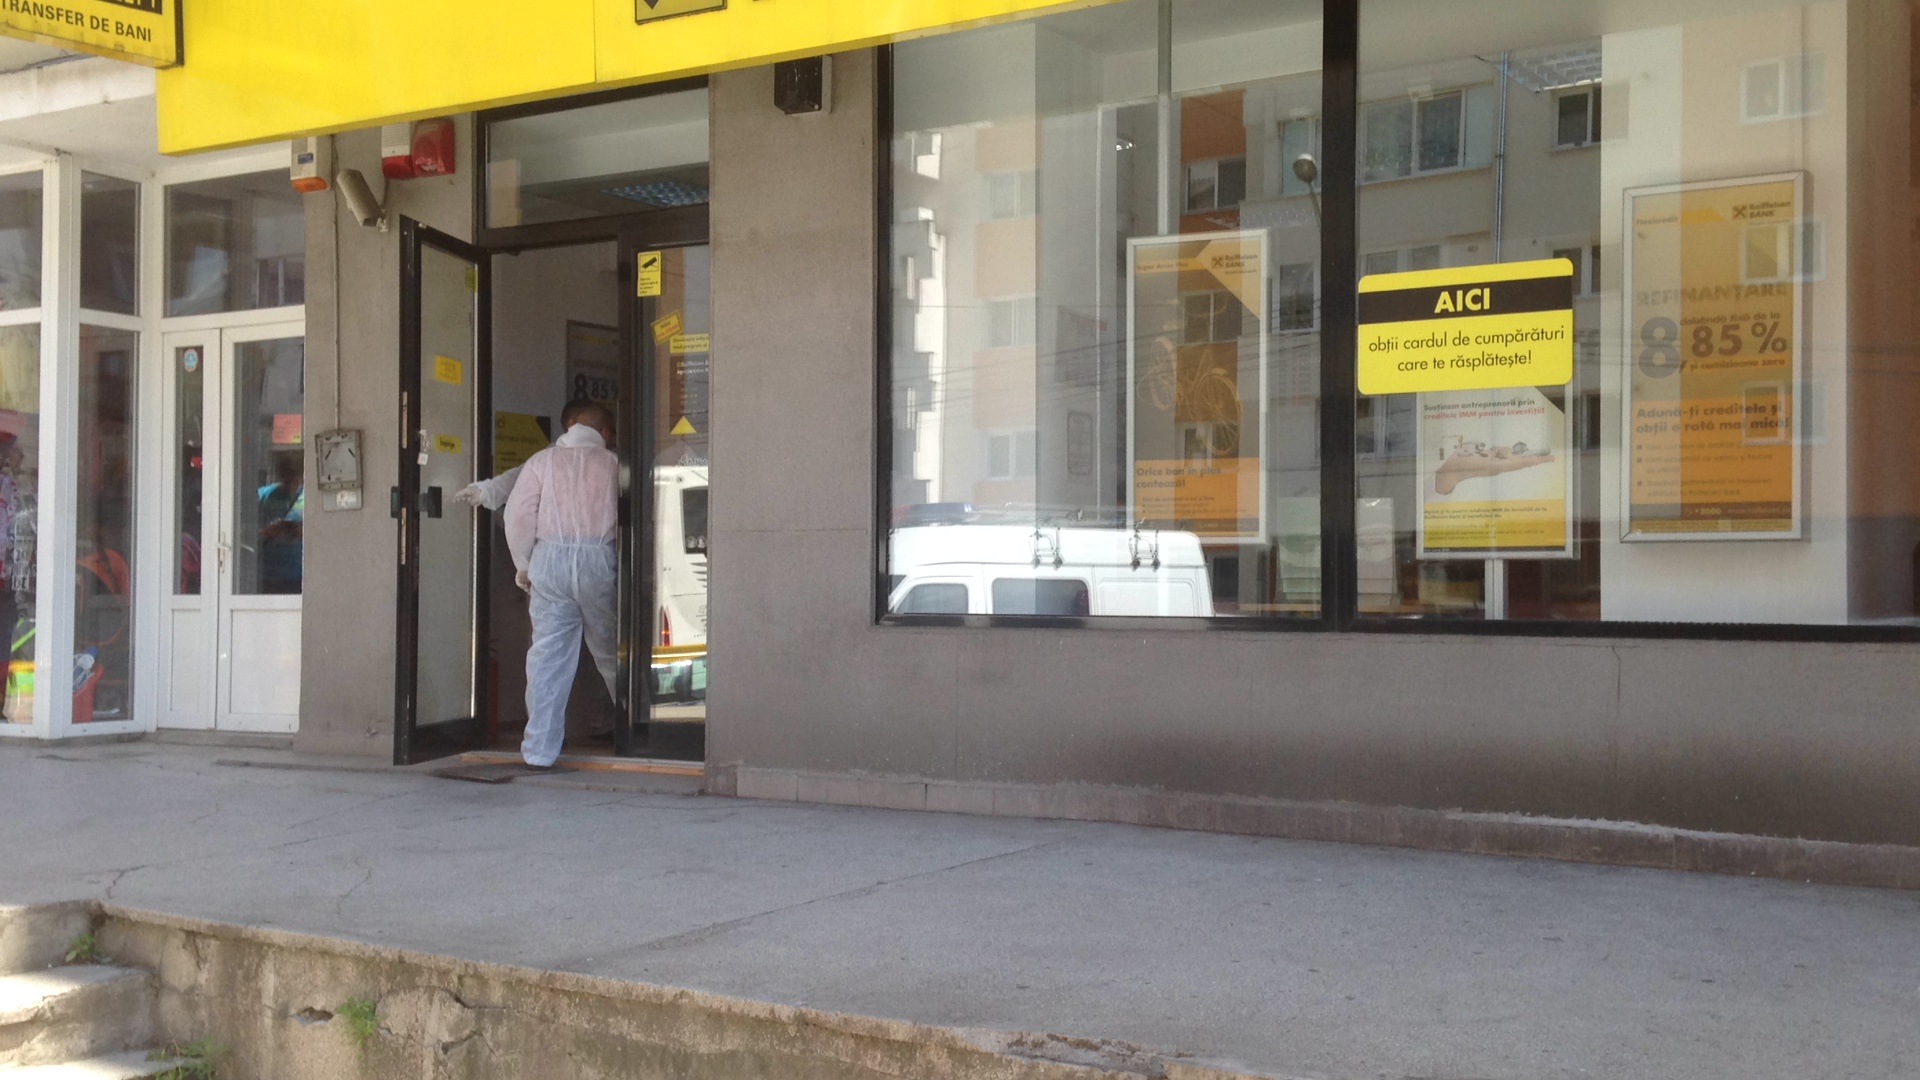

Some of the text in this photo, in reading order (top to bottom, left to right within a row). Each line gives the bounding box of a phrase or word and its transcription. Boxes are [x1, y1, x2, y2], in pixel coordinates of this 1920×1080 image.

[0, 0, 85, 27] TRANSFER
[89, 15, 110, 33] DE
[115, 21, 151, 42] BANI
[1749, 201, 1791, 210] Raiffeisen
[1749, 210, 1776, 219] BANK
[1224, 253, 1258, 261] Raiffeisen
[1224, 261, 1245, 269] BANK
[1434, 287, 1491, 314] AICI
[1753, 312, 1768, 321] de
[1770, 311, 1781, 320] la
[1368, 325, 1564, 353] obții cardul de cumpărături
[1398, 350, 1532, 372] care te răsplătește!
[1761, 358, 1785, 366] zero
[1517, 397, 1536, 408] prin
[1478, 409, 1506, 419] pentru
[1702, 403, 1767, 416] creditele
[1136, 467, 1163, 476] Orice
[1166, 467, 1185, 476] ban
[1200, 467, 1222, 478] plus
